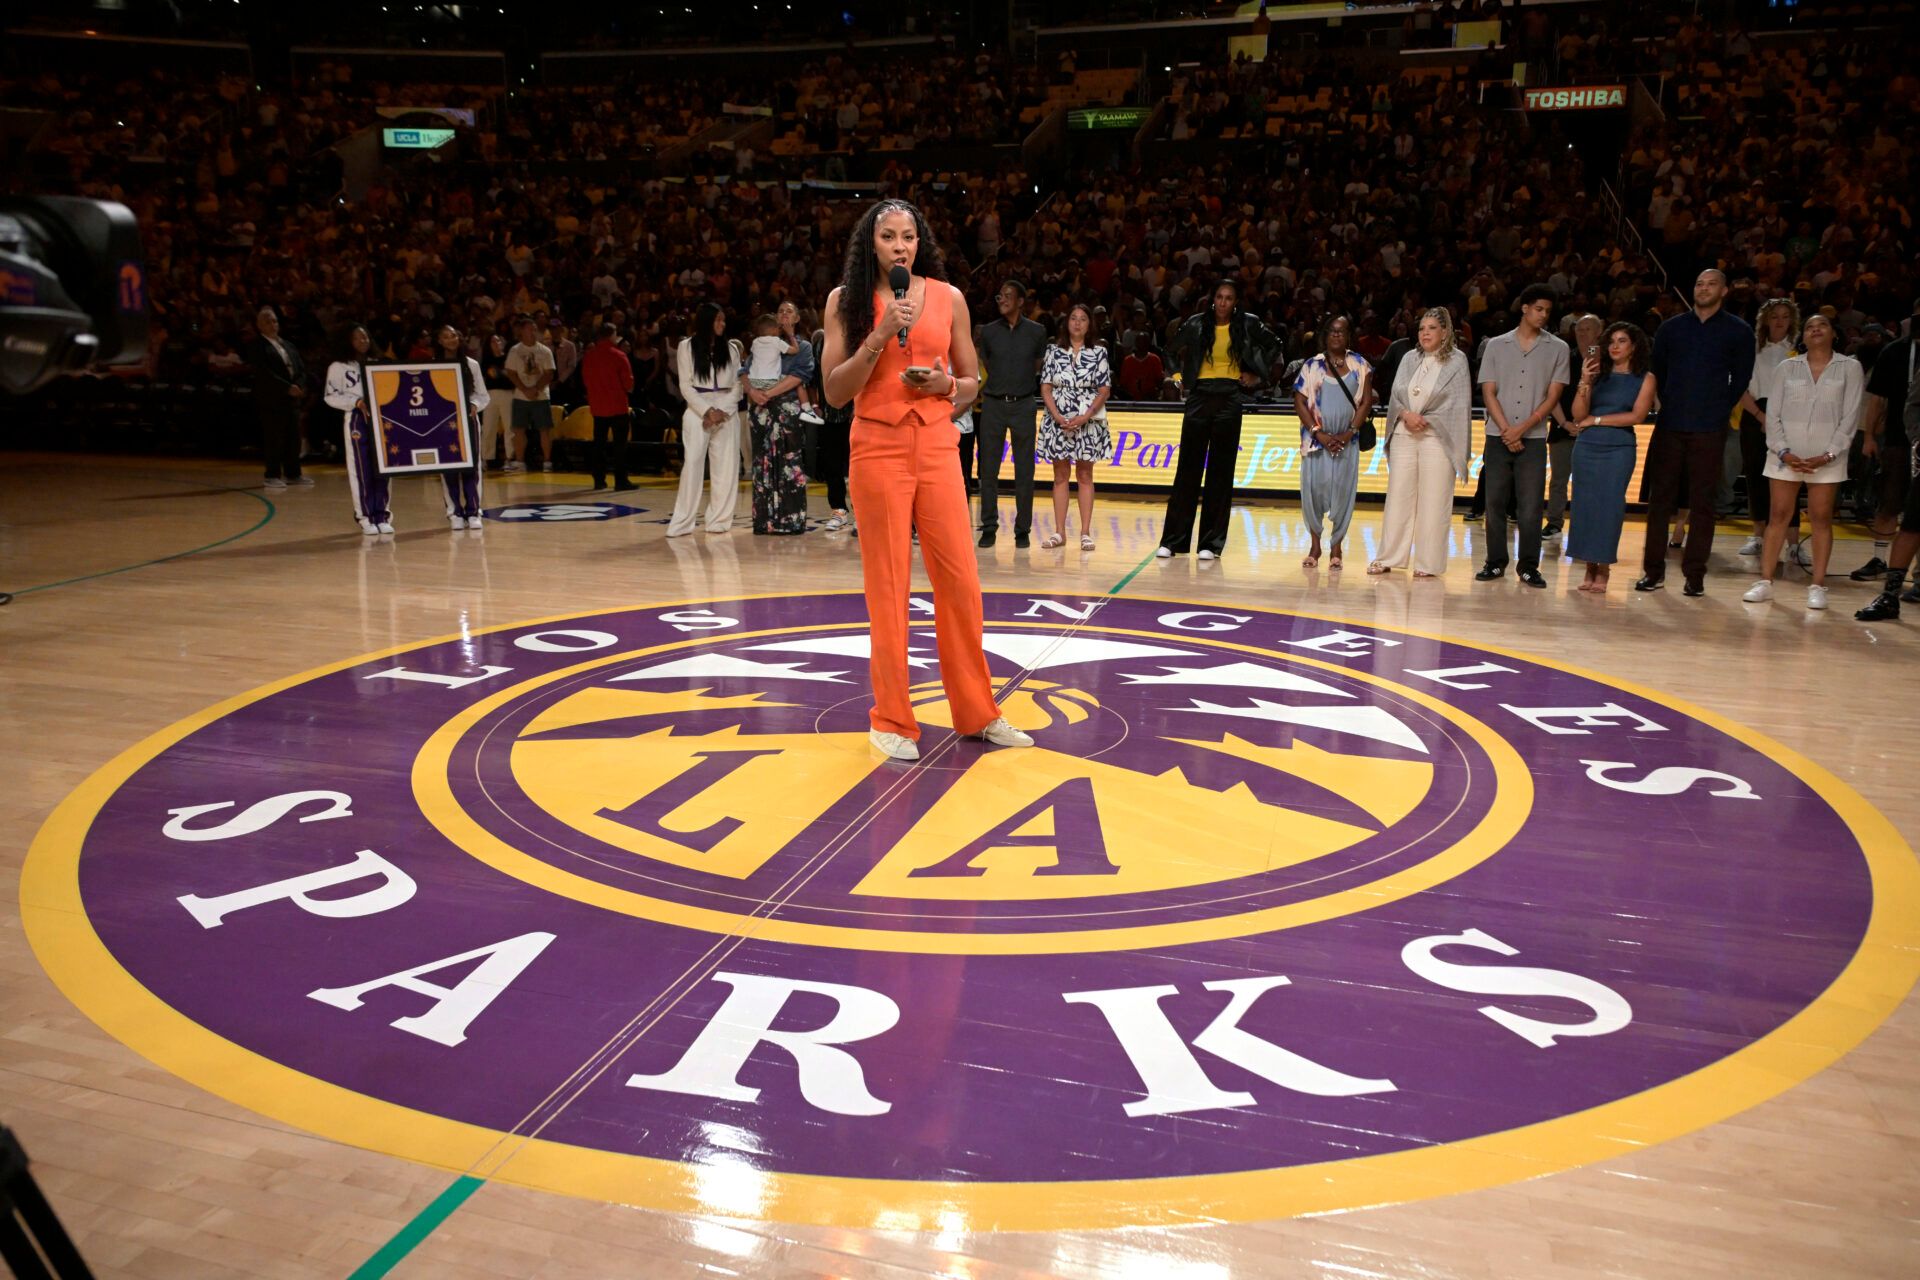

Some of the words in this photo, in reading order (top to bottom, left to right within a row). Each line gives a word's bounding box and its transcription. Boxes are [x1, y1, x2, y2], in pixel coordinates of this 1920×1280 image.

[1526, 89, 1623, 109] TOSHIBA
[396, 132, 418, 142] UCLA
[409, 386, 424, 407] 3
[1234, 434, 1301, 486] Jer
[362, 609, 739, 690] LOS
[593, 749, 1121, 878] LA
[162, 790, 1633, 1118] SPARKS
